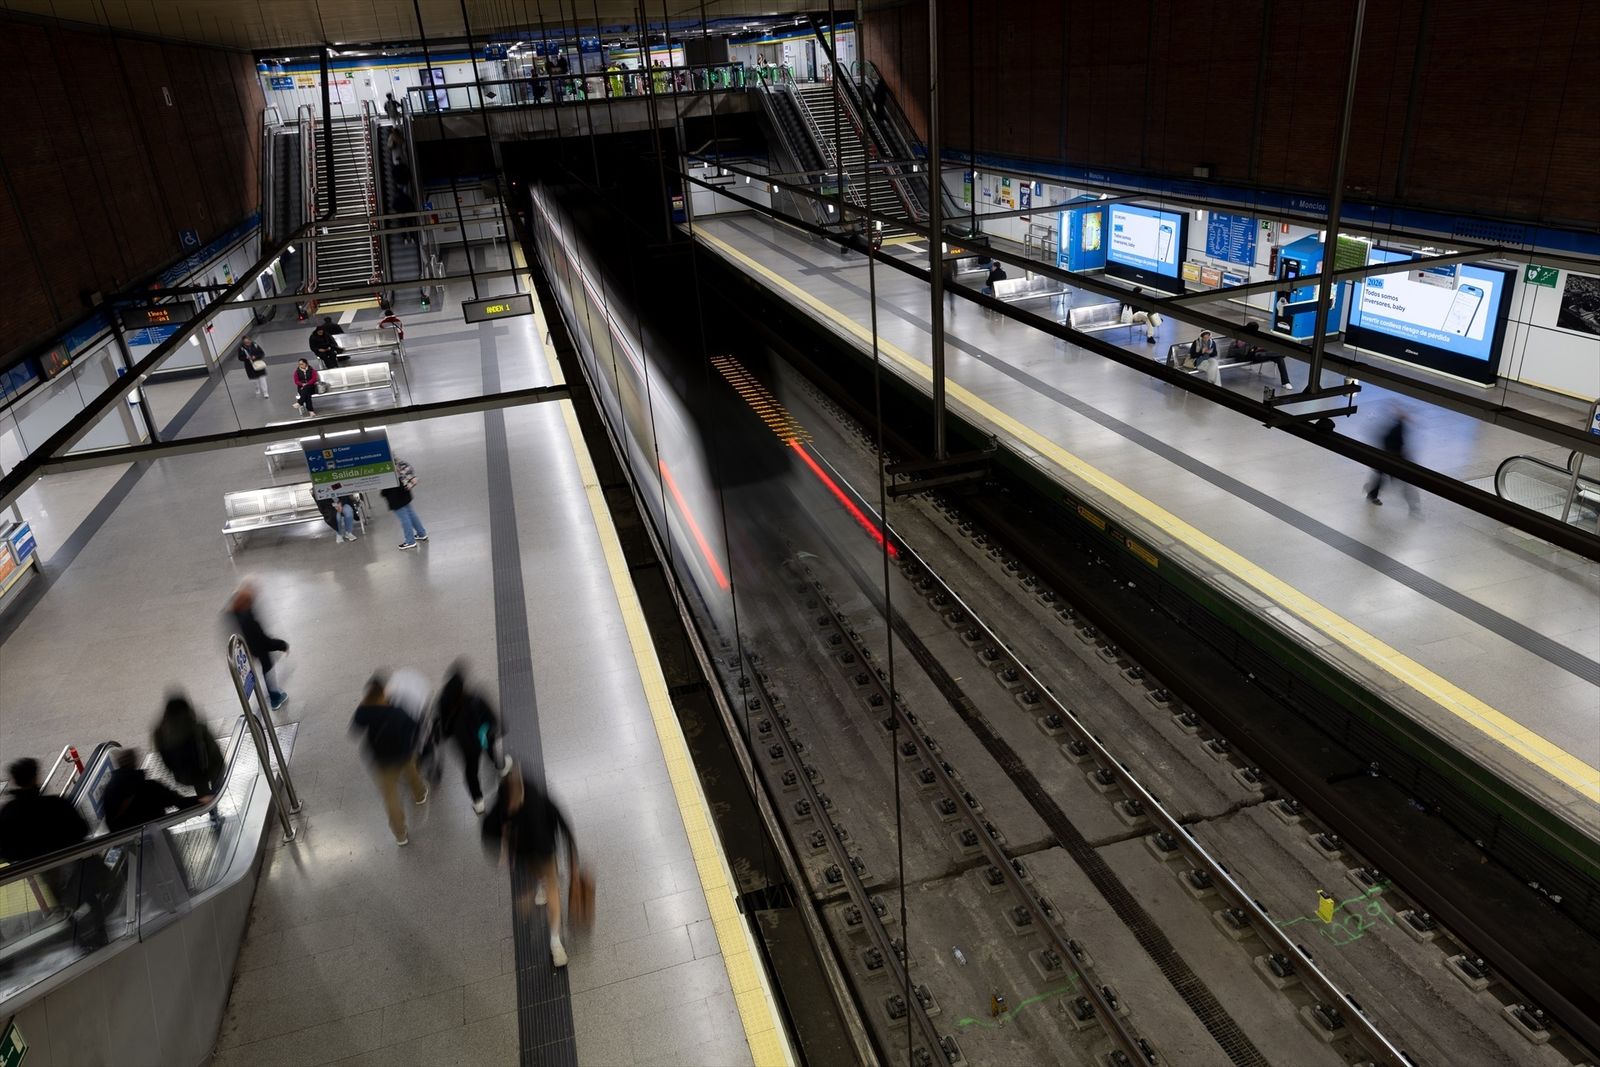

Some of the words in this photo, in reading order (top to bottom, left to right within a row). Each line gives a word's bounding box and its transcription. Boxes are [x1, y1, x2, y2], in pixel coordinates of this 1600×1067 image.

[1365, 289, 1380, 298] Todos
[1381, 293, 1398, 302] somos
[1392, 303, 1405, 312] baby
[332, 469, 359, 480] Salida
